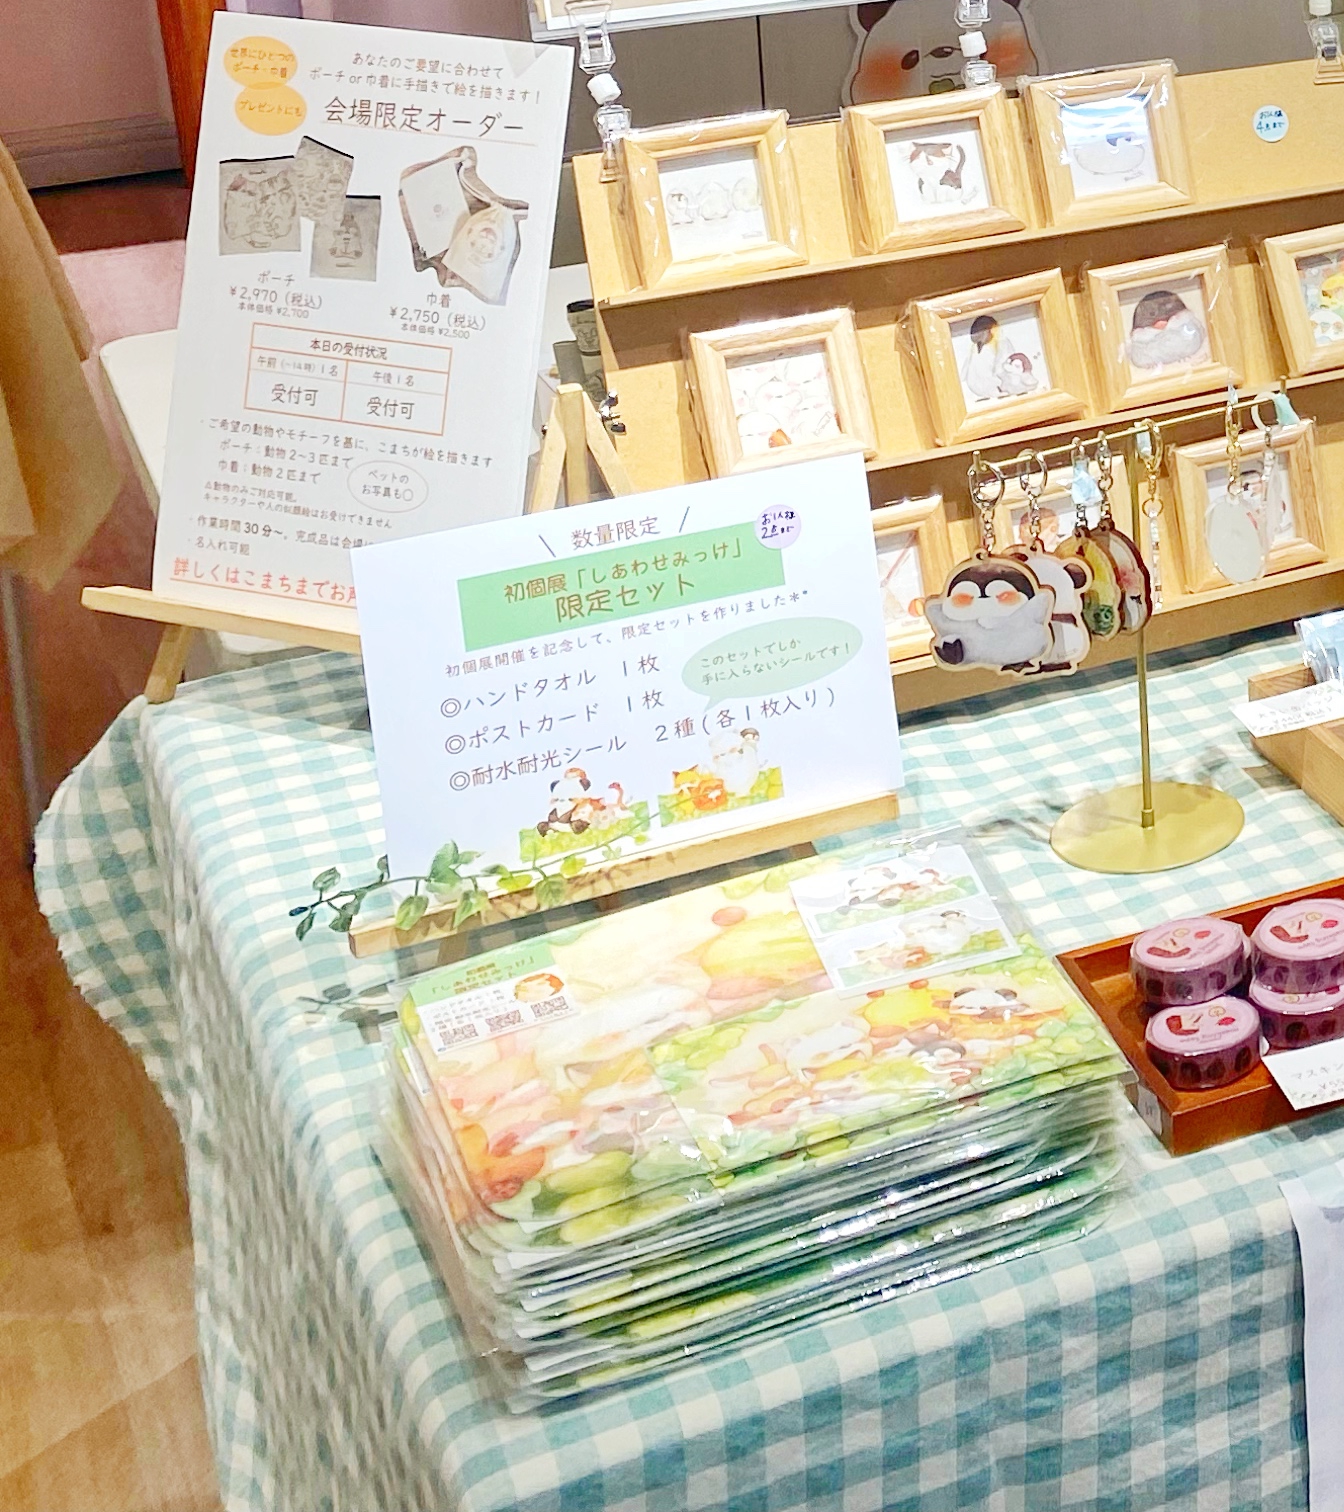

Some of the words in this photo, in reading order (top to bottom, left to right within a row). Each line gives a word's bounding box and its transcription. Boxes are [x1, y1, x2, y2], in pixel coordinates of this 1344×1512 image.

[309, 68, 345, 82] ポーチ
[352, 52, 505, 79] あなたのご要望に合わせて
[324, 96, 524, 138] 会場限定オーダー
[257, 270, 295, 287] ポーチ
[426, 292, 451, 308] 巾着
[310, 338, 388, 360] 本日の受付状況
[271, 384, 318, 406] 受付可
[367, 397, 415, 420] 受付可
[367, 470, 410, 484] ペットの
[571, 517, 661, 551] 数量限定
[504, 538, 742, 604] 初個展「しあわせみっけ」
[555, 573, 695, 623] 限定セット
[700, 637, 802, 669] このセットでしか
